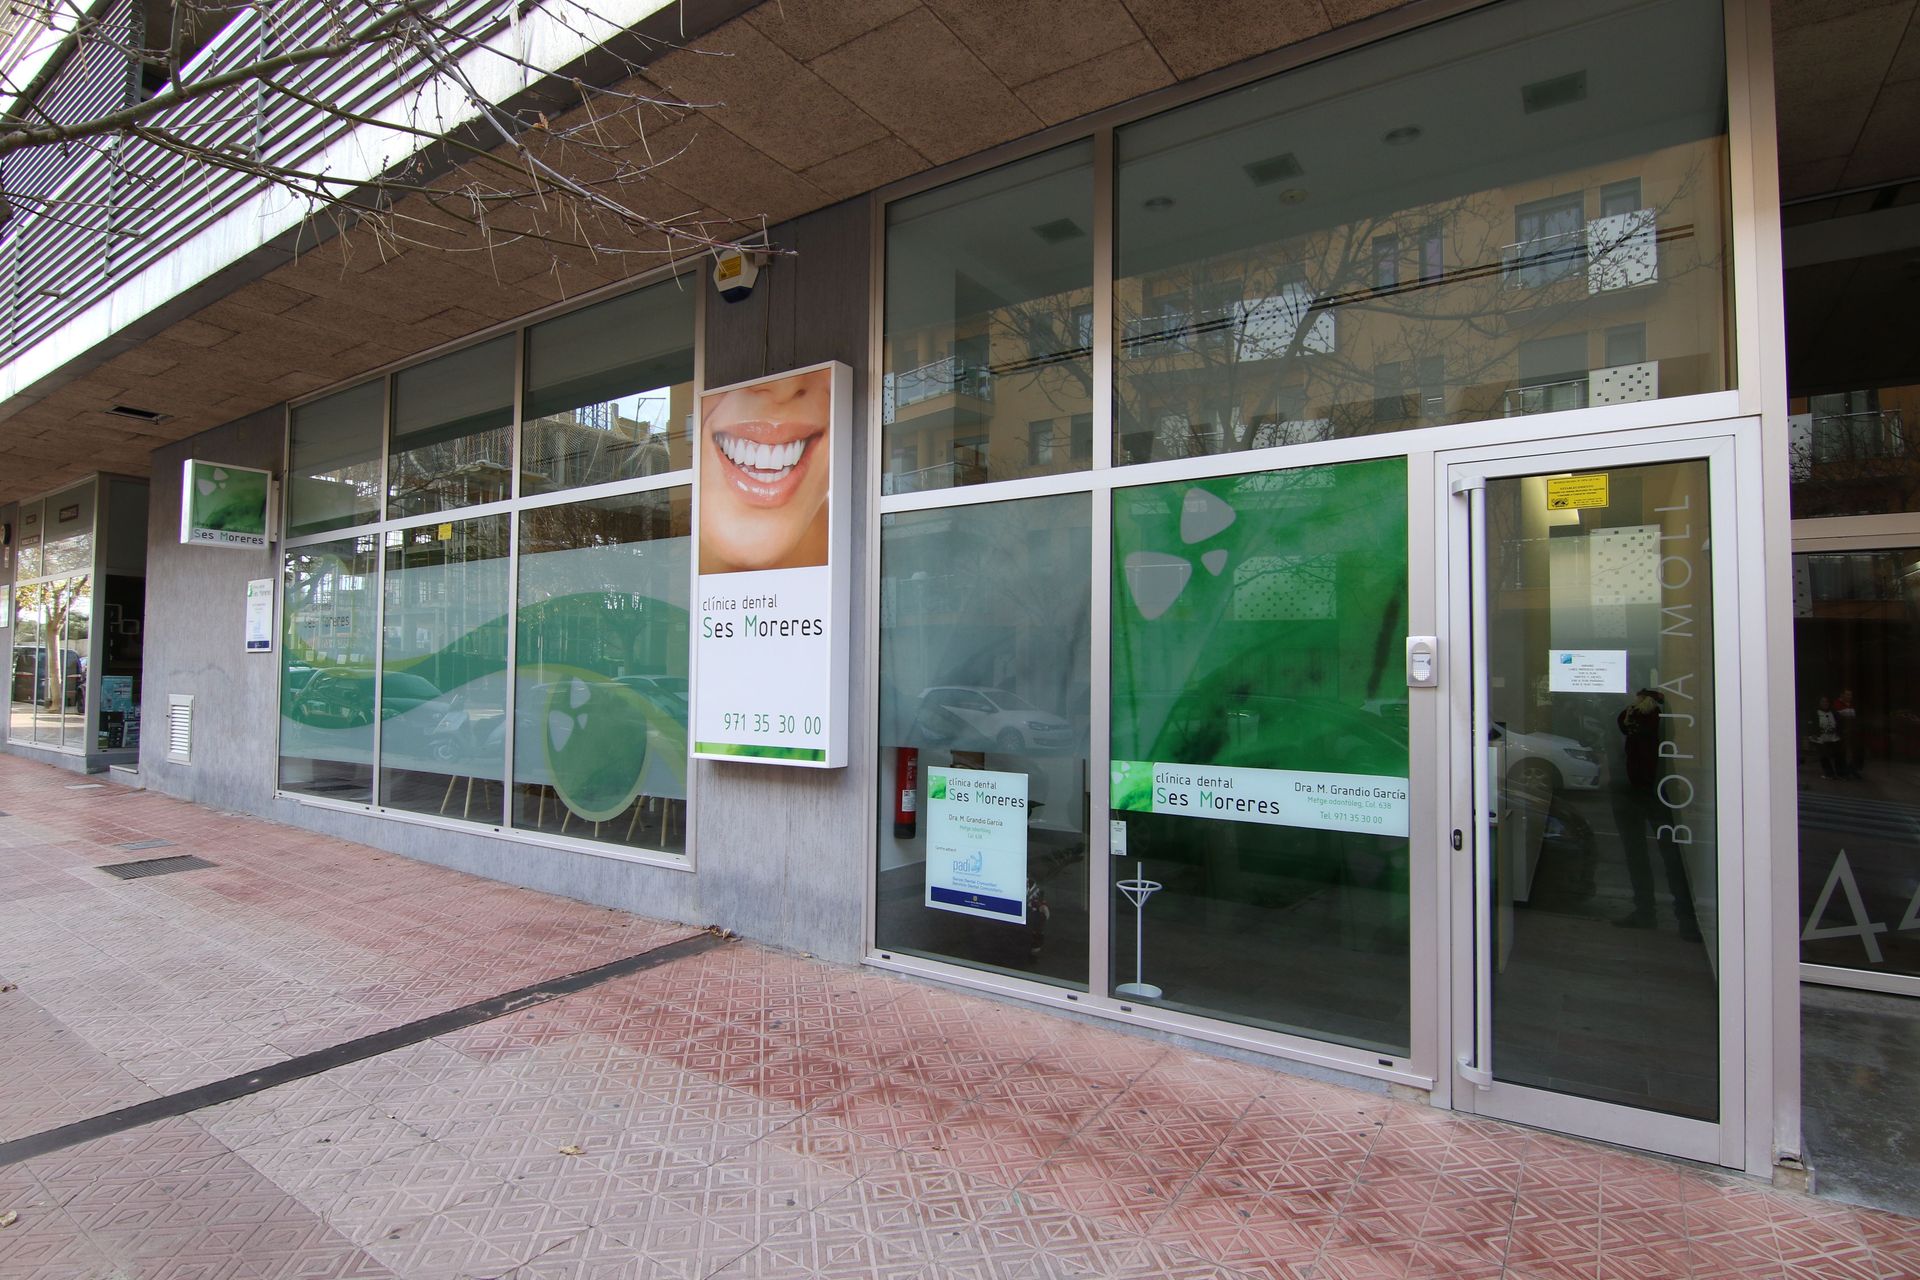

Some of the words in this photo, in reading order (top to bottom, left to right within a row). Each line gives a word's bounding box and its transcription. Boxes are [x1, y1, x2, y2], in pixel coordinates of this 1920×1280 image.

[194, 529, 214, 540] Ses
[220, 532, 264, 545] Moreres
[1654, 495, 1693, 638] MOLL
[702, 596, 736, 611] clínica
[742, 594, 777, 610] dental
[703, 616, 734, 638] Ses
[744, 614, 823, 637] Moreres
[724, 712, 746, 732] 971
[754, 714, 770, 732] 35
[779, 715, 795, 733] 30
[804, 716, 822, 735] 00
[948, 777, 971, 788] clínica
[974, 779, 997, 790] dental
[1156, 772, 1191, 786] clínica
[1196, 776, 1234, 789] dental
[949, 788, 970, 802] Ses
[976, 792, 1025, 808] Moreres
[1294, 782, 1314, 793] Dra.
[1317, 784, 1328, 794] M.
[1330, 785, 1371, 797] Grandio
[1373, 788, 1407, 800] García
[1156, 787, 1189, 806] Ses
[1200, 790, 1280, 815] Moreres
[1378, 802, 1392, 810] 638
[1334, 812, 1347, 821] 971
[1350, 814, 1359, 822] 35
[1361, 815, 1371, 823] 30
[1373, 816, 1383, 824] 00
